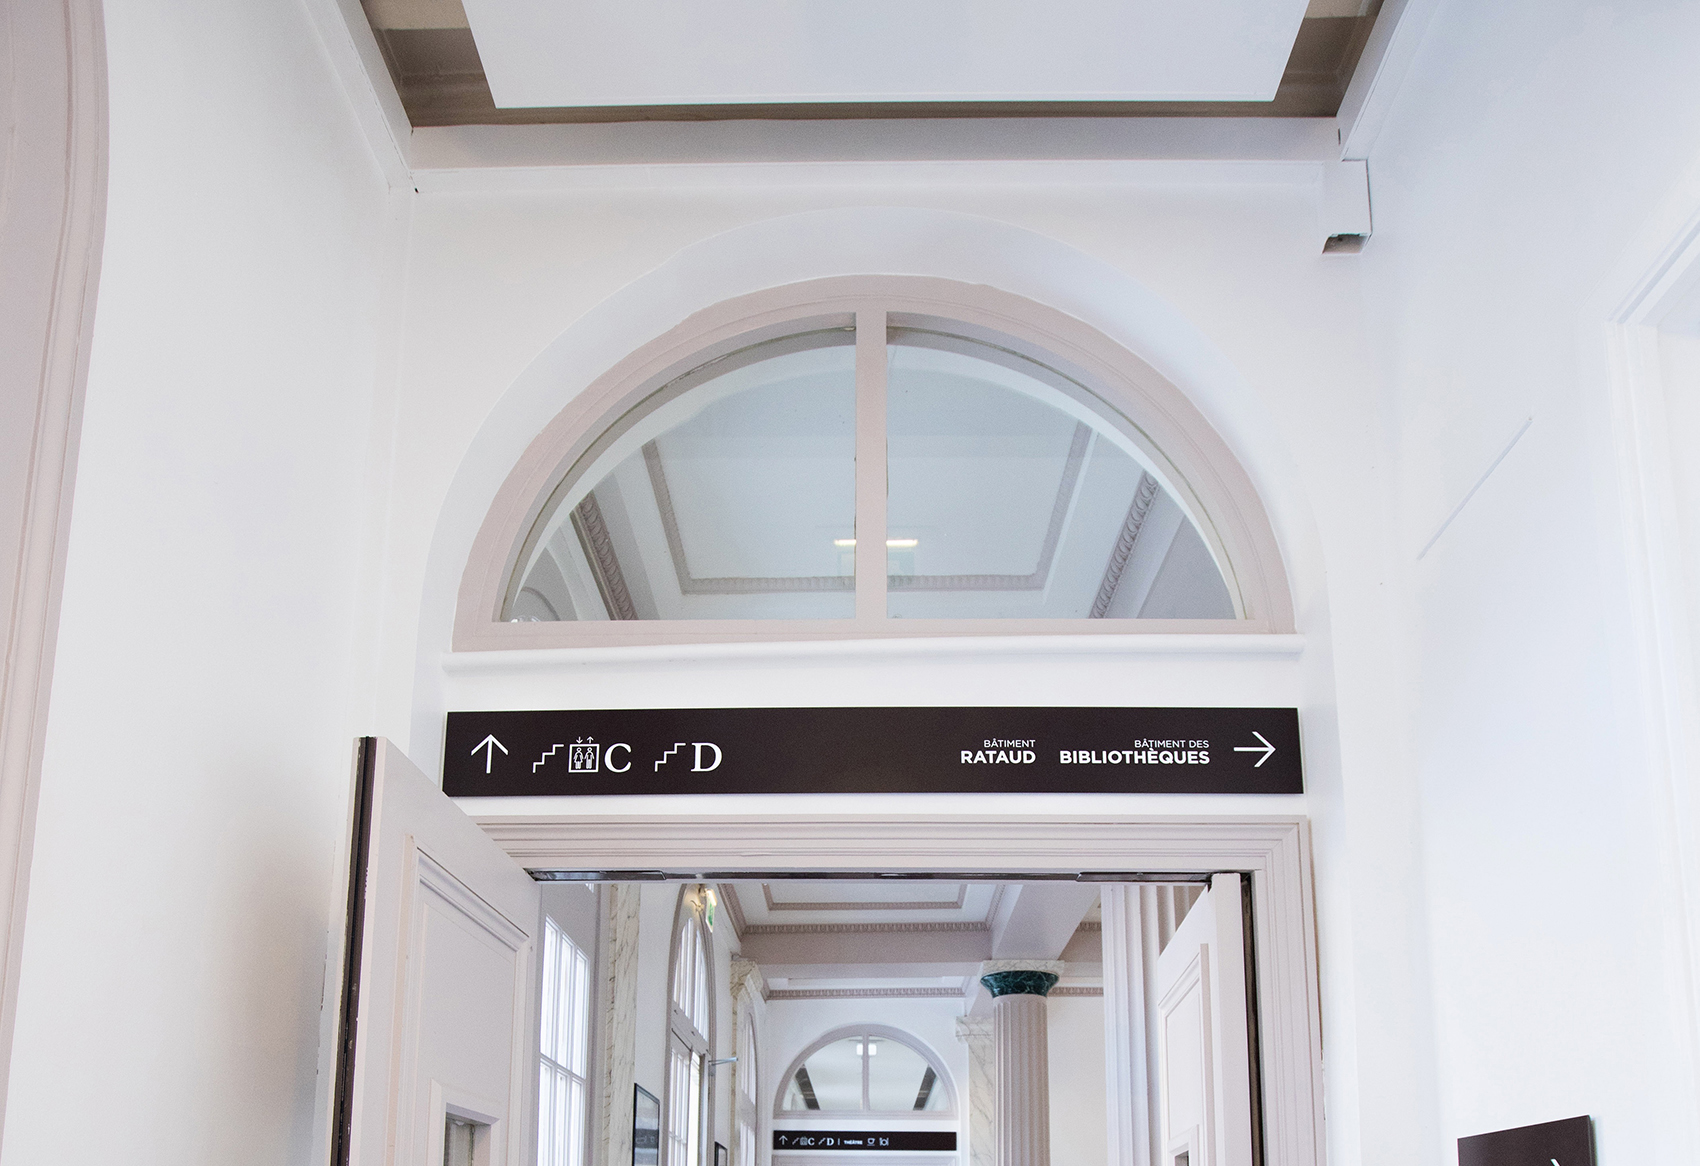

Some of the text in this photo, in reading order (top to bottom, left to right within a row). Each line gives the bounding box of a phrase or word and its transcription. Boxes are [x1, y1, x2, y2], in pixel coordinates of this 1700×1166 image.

[983, 738, 1036, 748] BÂTIMENT
[1134, 738, 1209, 748] BÂTIMENT DES
[604, 743, 632, 773] C
[690, 742, 723, 772] D
[960, 750, 1036, 764] RATAUD
[1059, 747, 1210, 765] BIBLIOTHÈQUES
[807, 1137, 815, 1146] C
[826, 1137, 835, 1146] D
